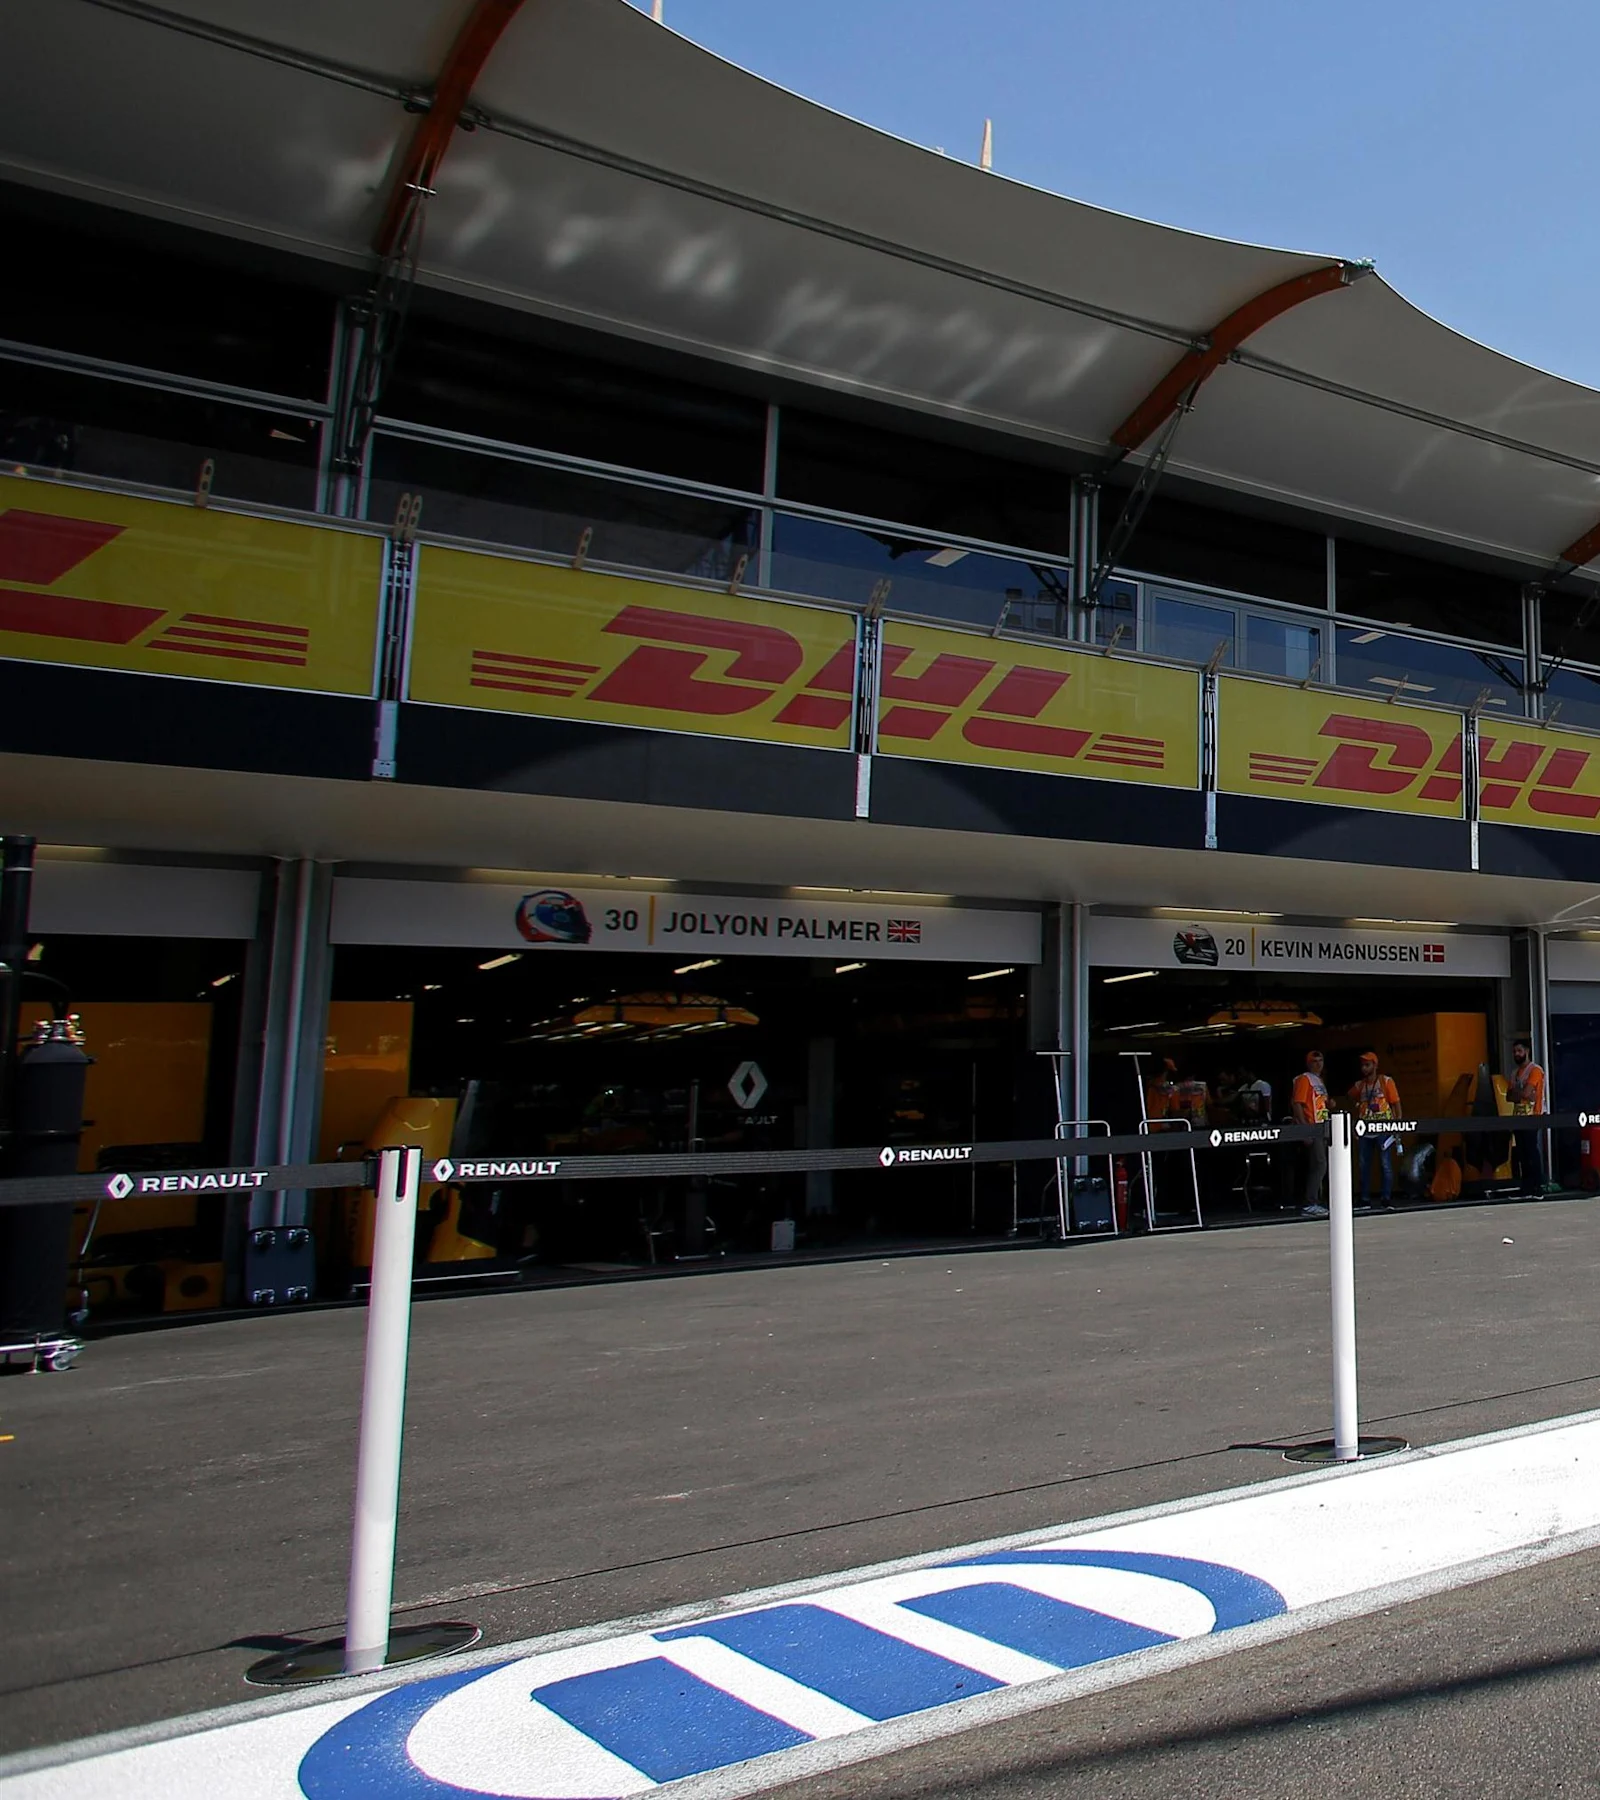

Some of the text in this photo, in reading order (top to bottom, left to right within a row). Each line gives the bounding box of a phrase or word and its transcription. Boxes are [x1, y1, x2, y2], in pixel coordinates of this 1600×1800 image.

[586, 603, 1093, 759] DHL
[605, 909, 881, 942] 30 JOLYON PALMER
[1224, 938, 1420, 962] 20 KEVIN MAGNUSSEN
[1224, 1129, 1281, 1143] RENAULT
[1367, 1120, 1418, 1133] RENAULT
[899, 1146, 972, 1164] RENAULT
[459, 1161, 561, 1178] RENAULT
[141, 1171, 268, 1192] RENAULT
